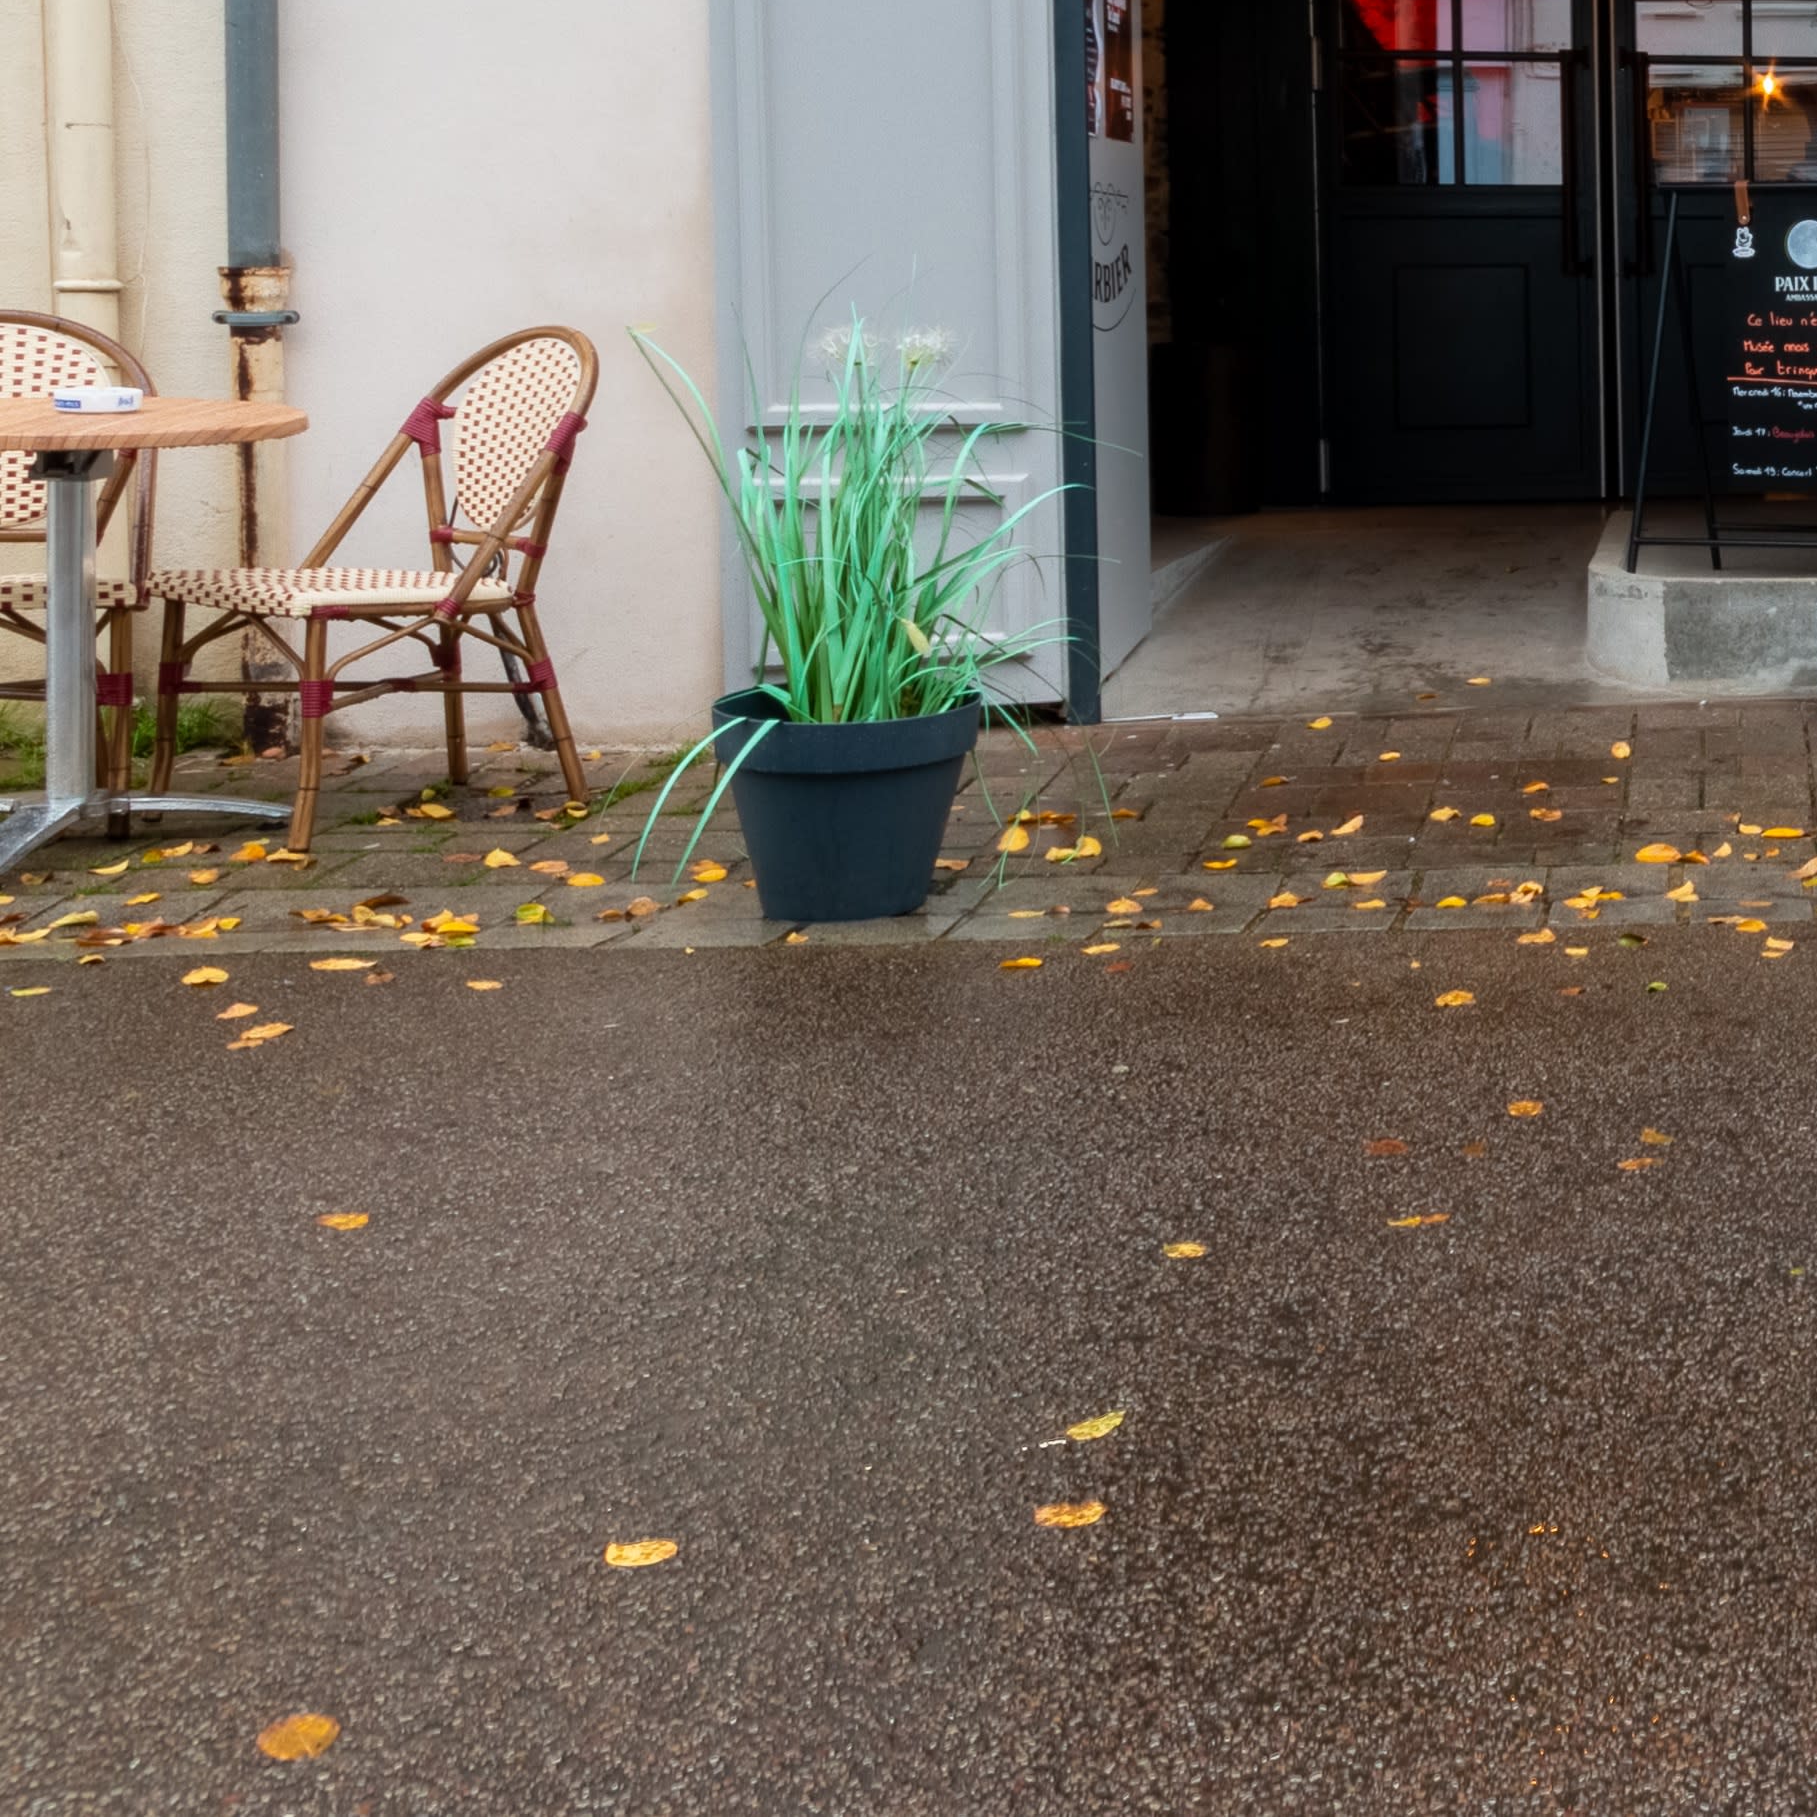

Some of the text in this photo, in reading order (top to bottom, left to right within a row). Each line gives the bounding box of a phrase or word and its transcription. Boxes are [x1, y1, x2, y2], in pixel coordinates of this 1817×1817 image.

[1092, 244, 1132, 303] RBIER
[1775, 275, 1810, 292] PAIX
[1747, 313, 1763, 327] Ce
[1769, 311, 1793, 327] lieu
[1783, 342, 1810, 353] mais
